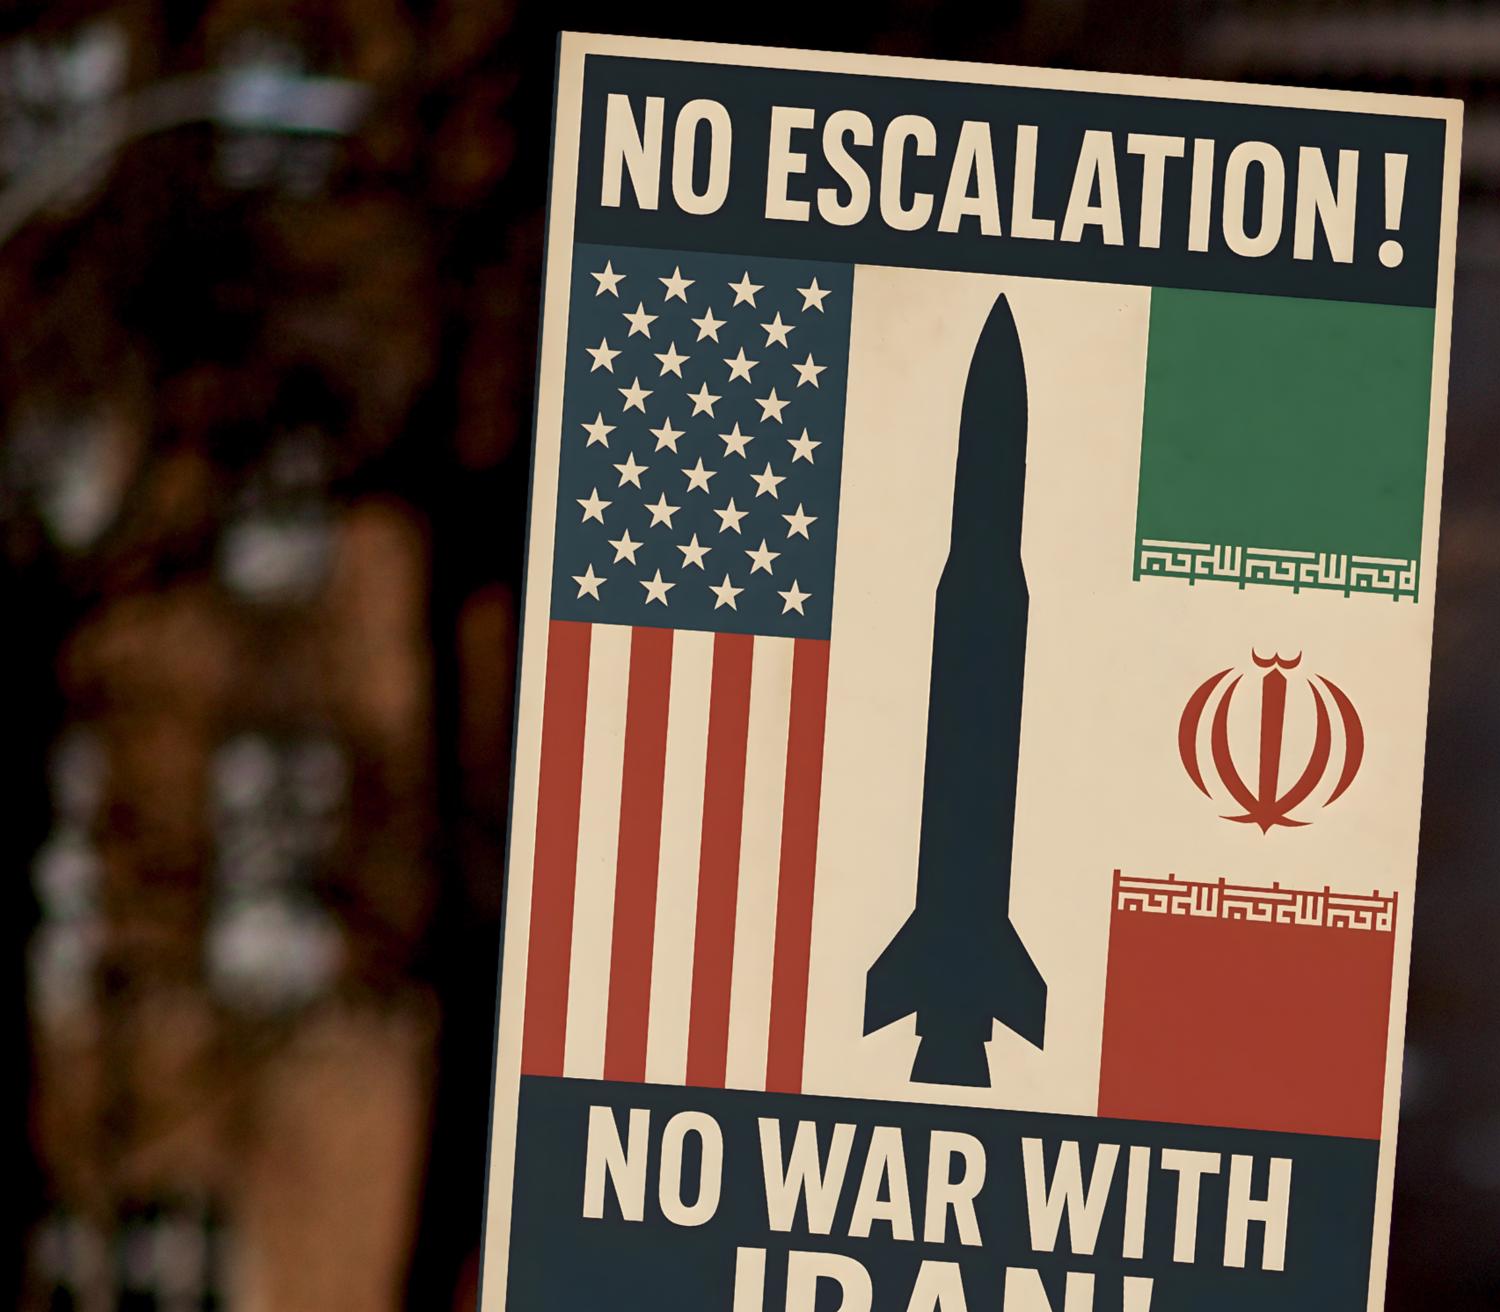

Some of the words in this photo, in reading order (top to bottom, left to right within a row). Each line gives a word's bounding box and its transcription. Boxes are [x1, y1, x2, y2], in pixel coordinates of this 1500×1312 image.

[601, 94, 732, 215] NO
[765, 106, 1408, 267] ESCALATION!
[583, 1105, 723, 1226] NO
[758, 1117, 986, 1246] WAR
[1022, 1137, 1292, 1271] WITH
